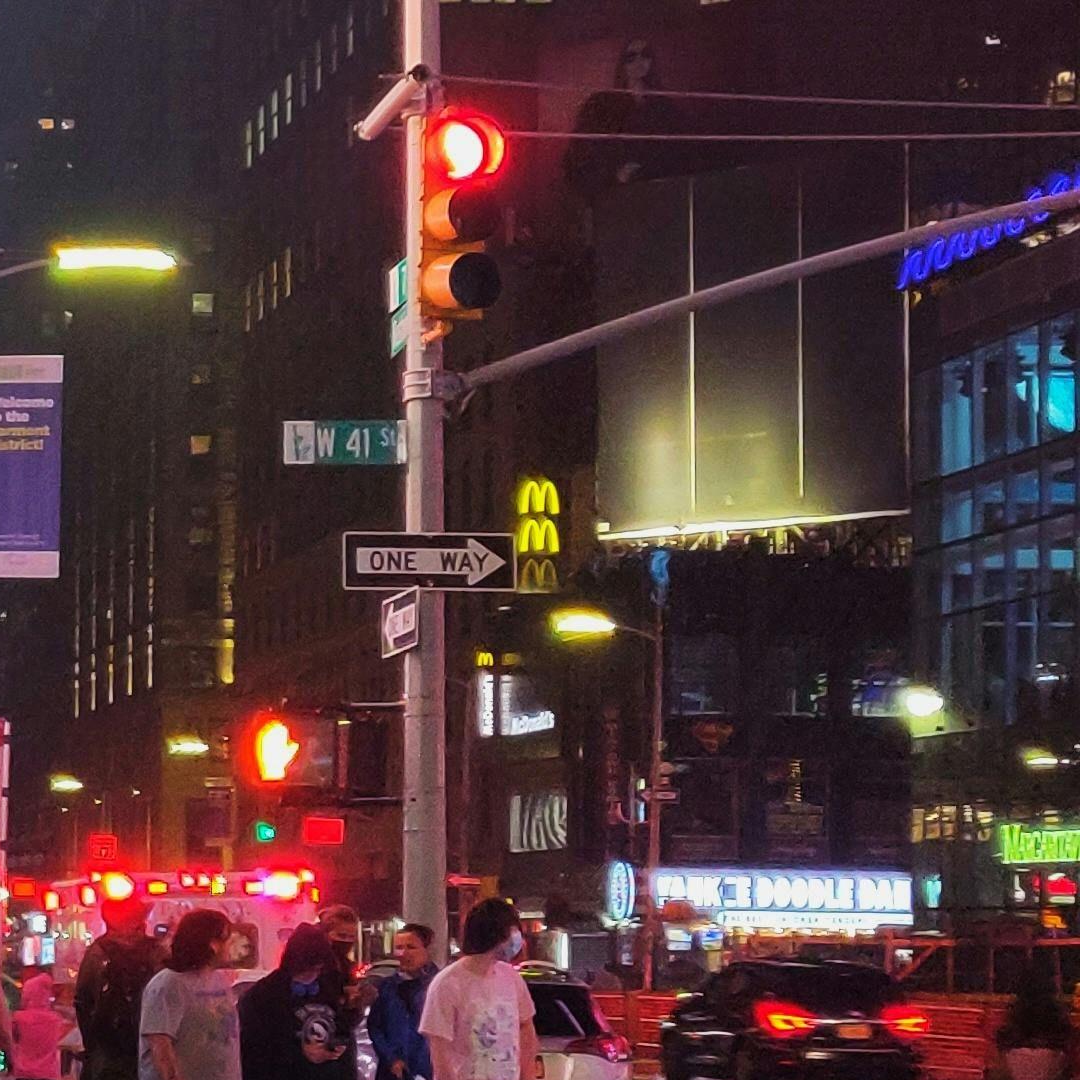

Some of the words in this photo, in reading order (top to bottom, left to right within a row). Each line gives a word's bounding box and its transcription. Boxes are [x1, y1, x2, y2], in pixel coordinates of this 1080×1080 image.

[5, 410, 30, 423] the
[316, 427, 335, 458] W
[346, 427, 370, 459] 41
[369, 550, 418, 572] ONE
[439, 551, 489, 573] WAY
[756, 876, 856, 910] DOODLE
